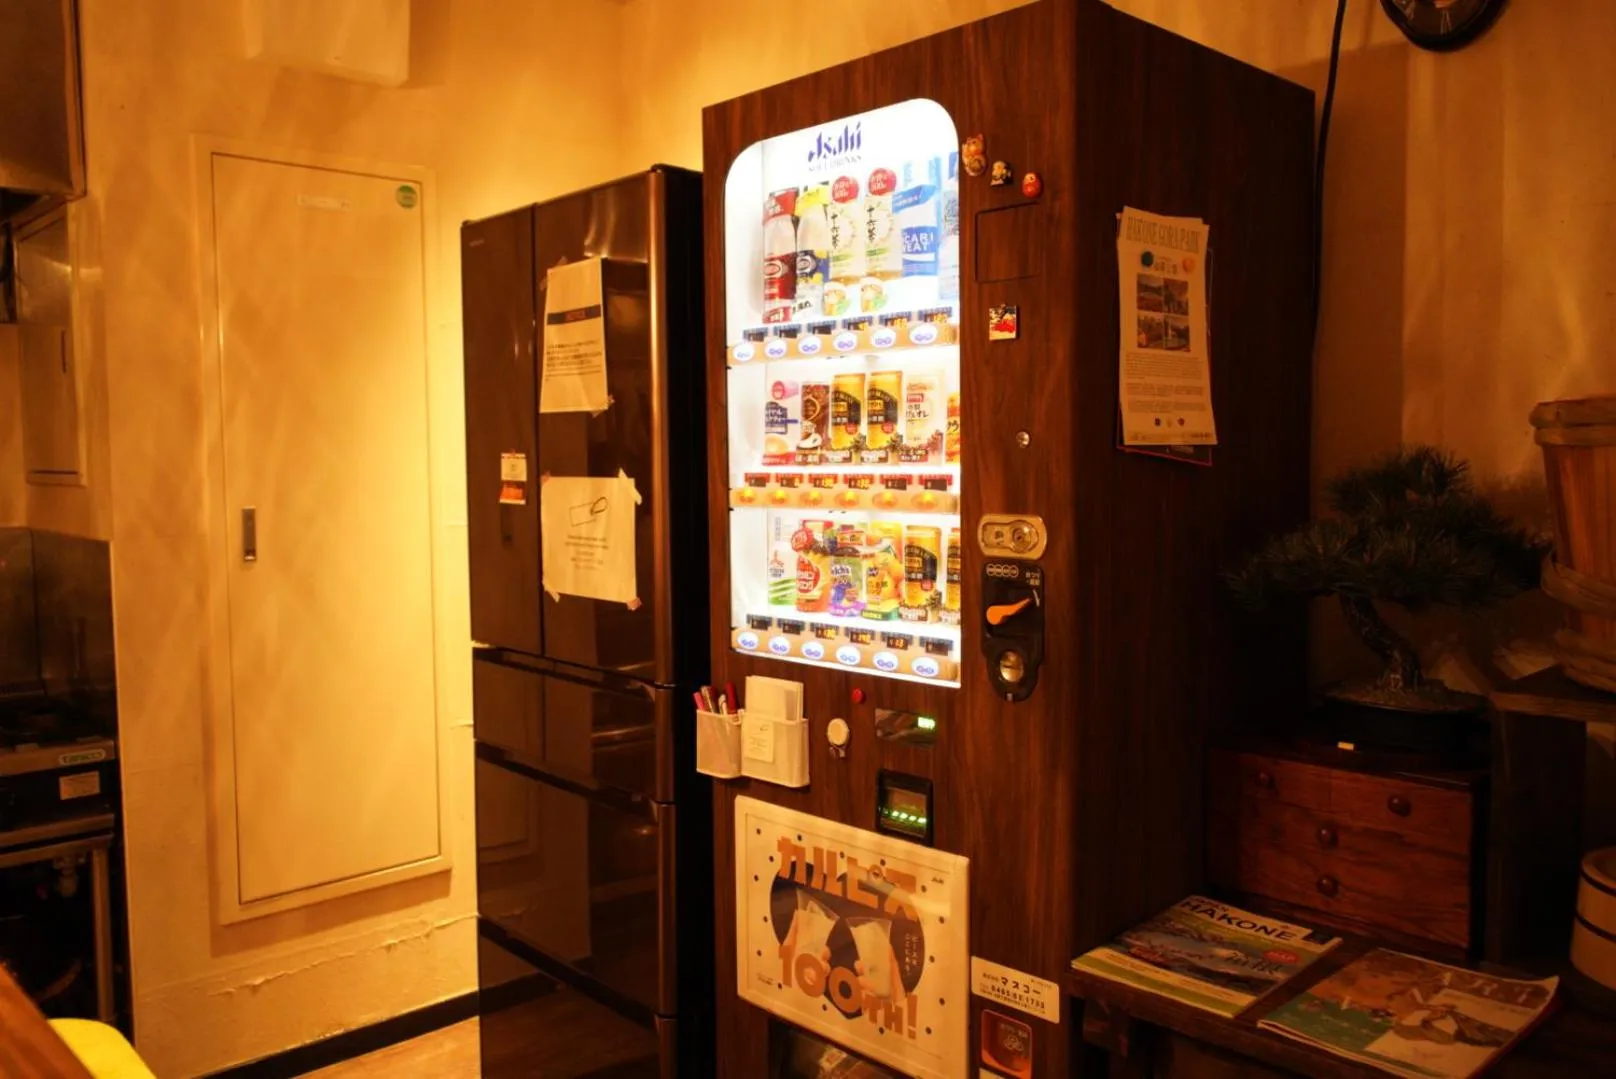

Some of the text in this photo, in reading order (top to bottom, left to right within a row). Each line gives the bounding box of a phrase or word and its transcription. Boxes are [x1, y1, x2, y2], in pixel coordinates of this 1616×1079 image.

[807, 121, 862, 163] Asahi
[776, 835, 919, 922] カルピス
[1178, 899, 1297, 942] HAKONE
[1000, 976, 1042, 996] マスコー
